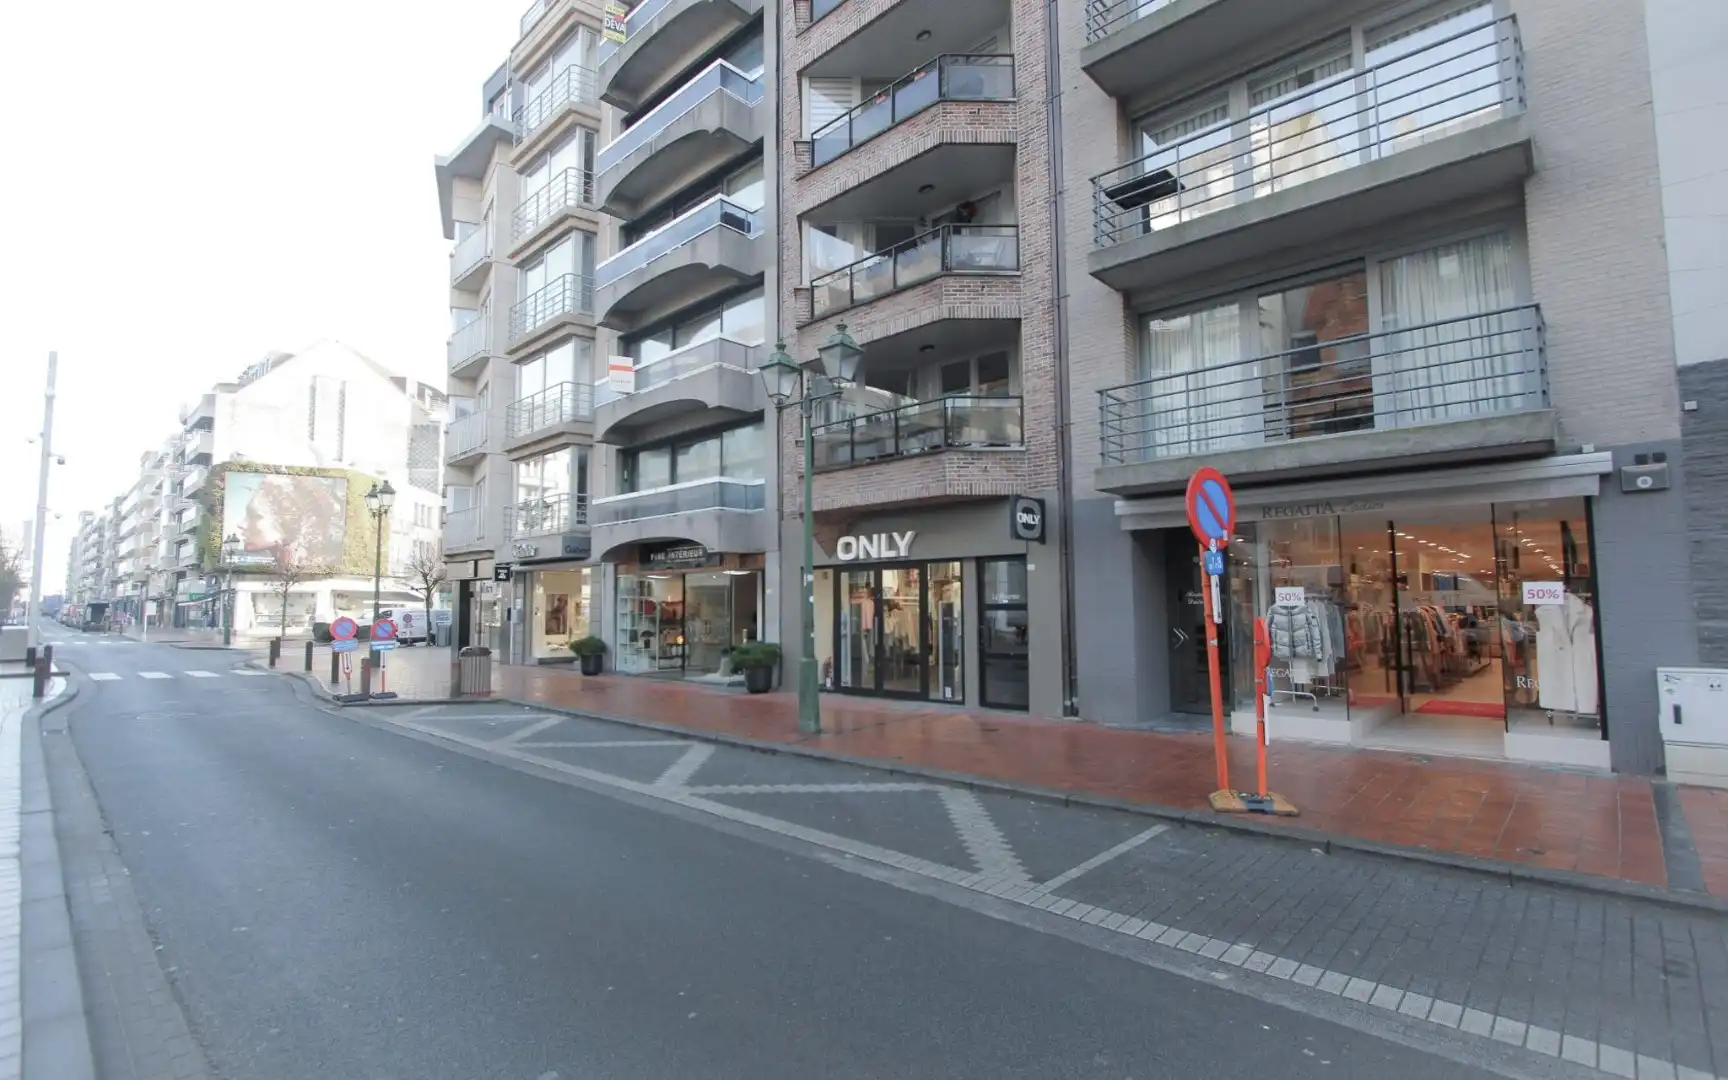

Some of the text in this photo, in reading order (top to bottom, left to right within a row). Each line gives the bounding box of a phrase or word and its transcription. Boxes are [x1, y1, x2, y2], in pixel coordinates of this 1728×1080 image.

[1262, 500, 1335, 519] REGATTA
[1017, 512, 1040, 525] ONLY
[836, 531, 917, 561] ONLY
[1278, 592, 1302, 602] 50%
[1527, 589, 1560, 600] 50%
